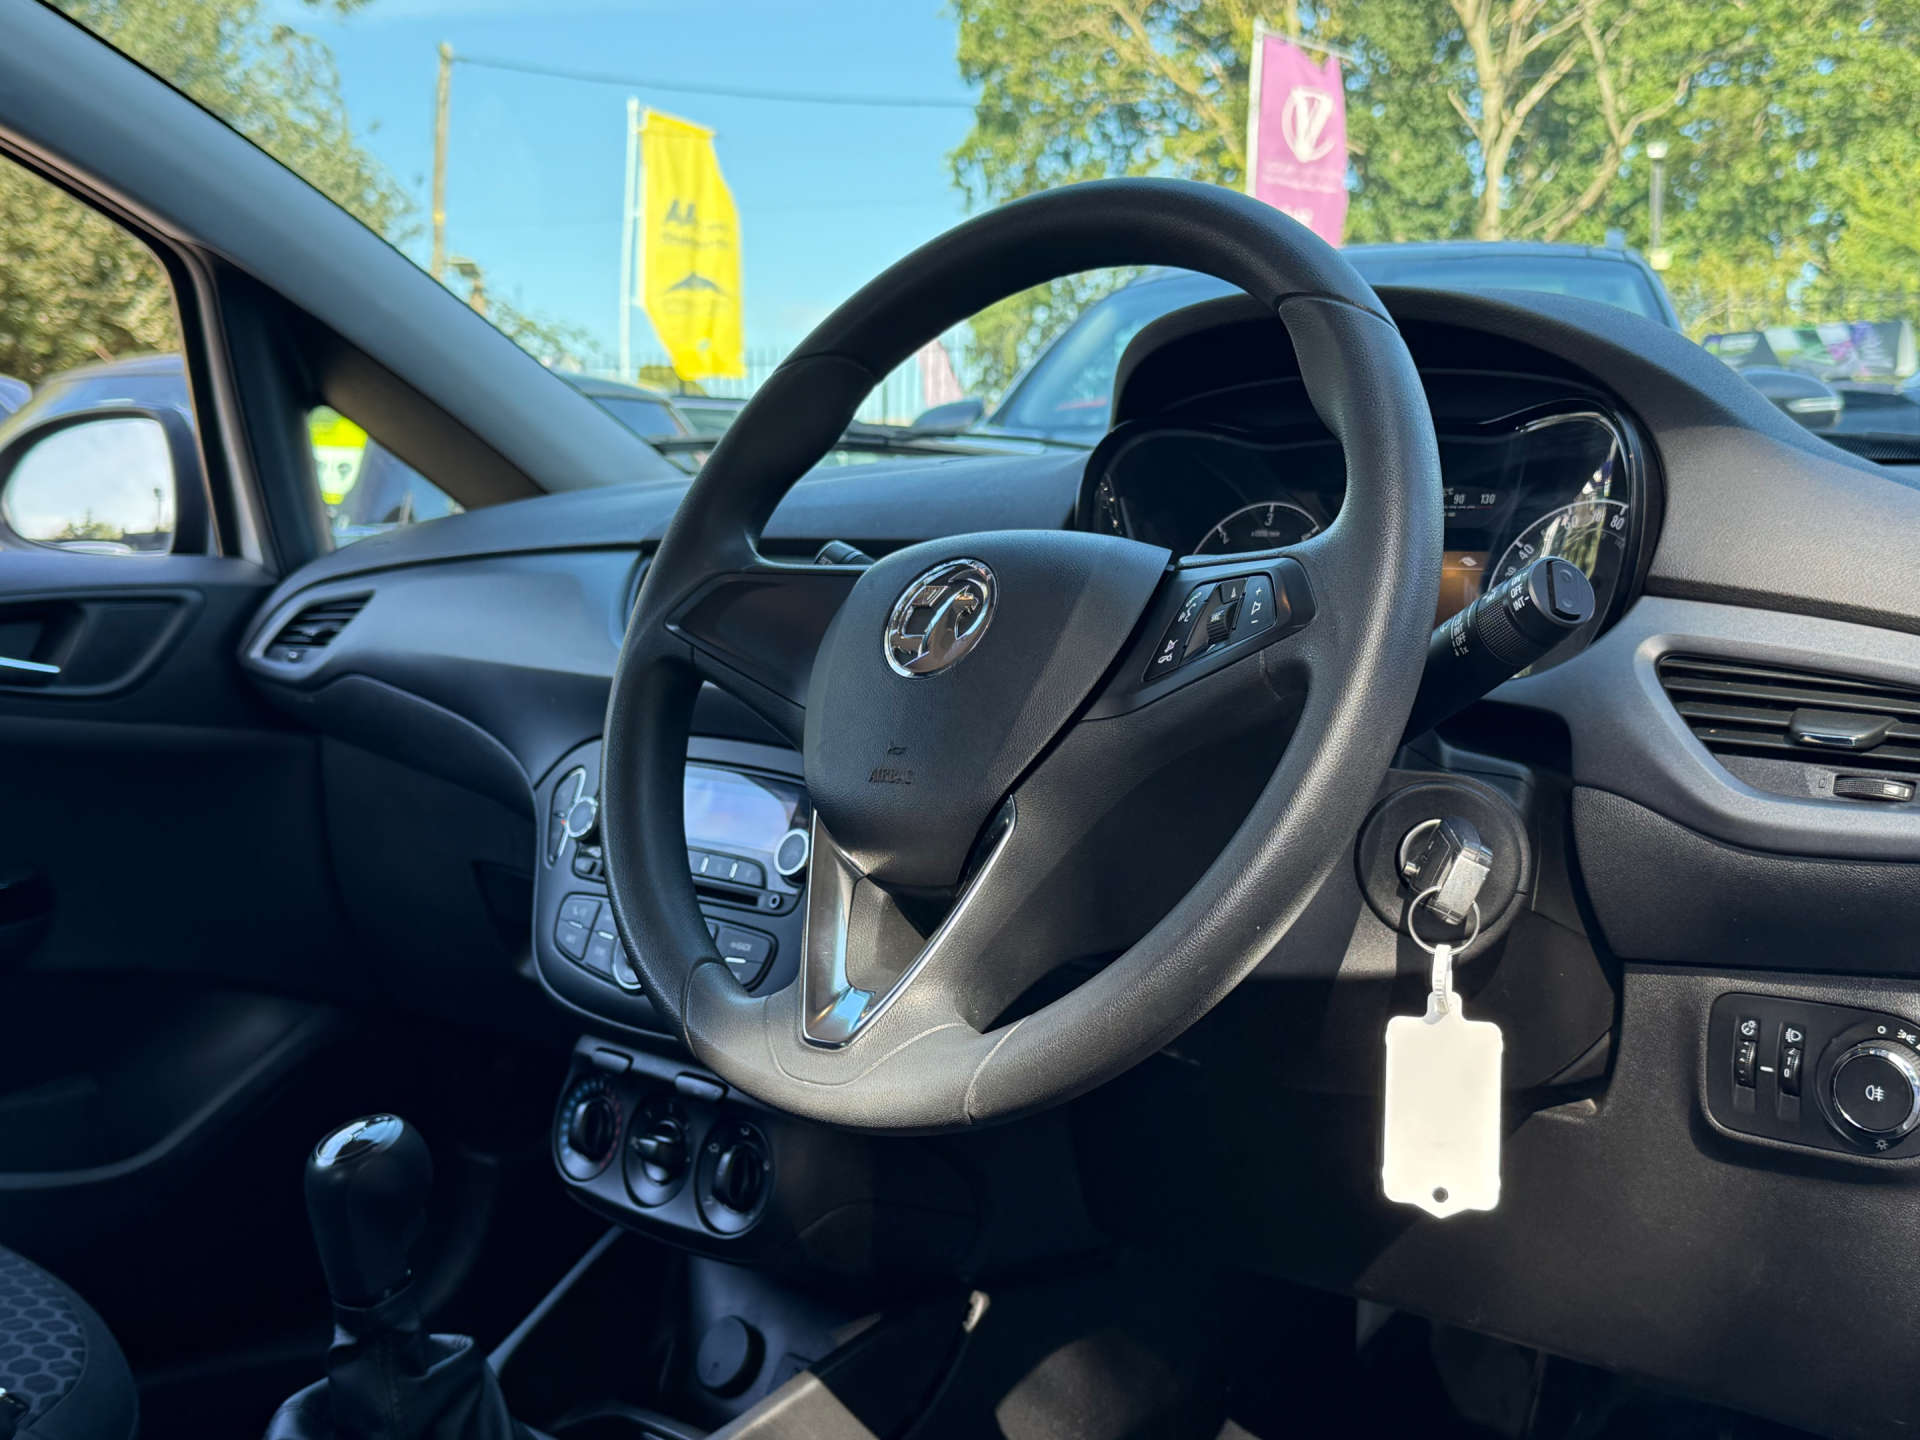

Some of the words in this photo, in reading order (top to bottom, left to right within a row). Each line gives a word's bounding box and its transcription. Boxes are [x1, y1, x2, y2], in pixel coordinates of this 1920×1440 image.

[1610, 514, 1625, 530] 80
[1518, 543, 1535, 560] 40
[1510, 583, 1523, 598] OFF
[1512, 595, 1526, 612] INT
[1455, 631, 1467, 646] OFF
